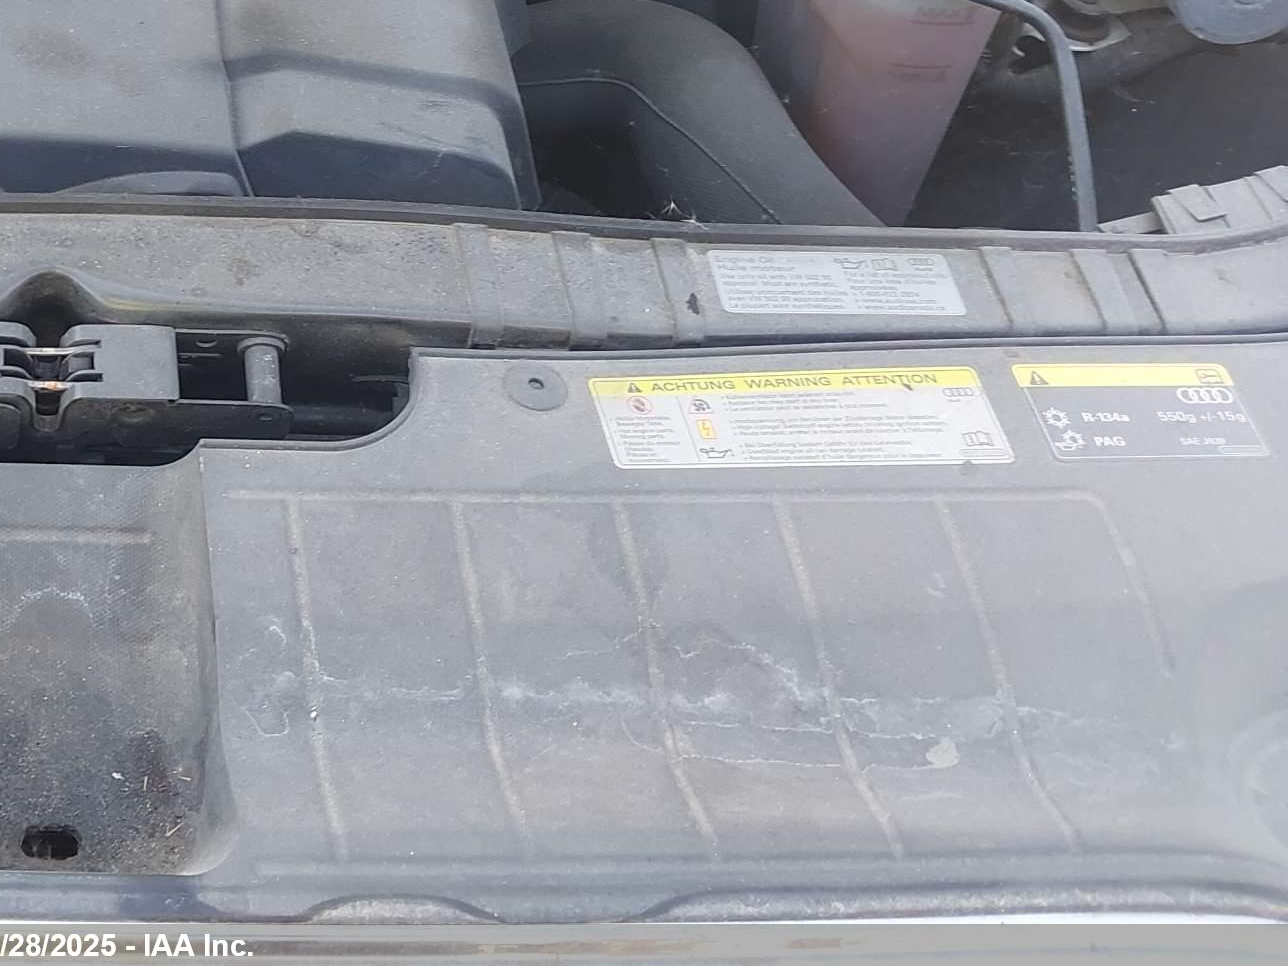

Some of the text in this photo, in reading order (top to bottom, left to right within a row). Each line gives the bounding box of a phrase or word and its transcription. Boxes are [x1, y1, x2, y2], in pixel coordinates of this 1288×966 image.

[651, 373, 938, 392] ACHTUNG WARNING ATTENTION
[1080, 411, 1130, 422] R-134a
[1158, 411, 1196, 423] 550g
[1094, 436, 1126, 446] PAG
